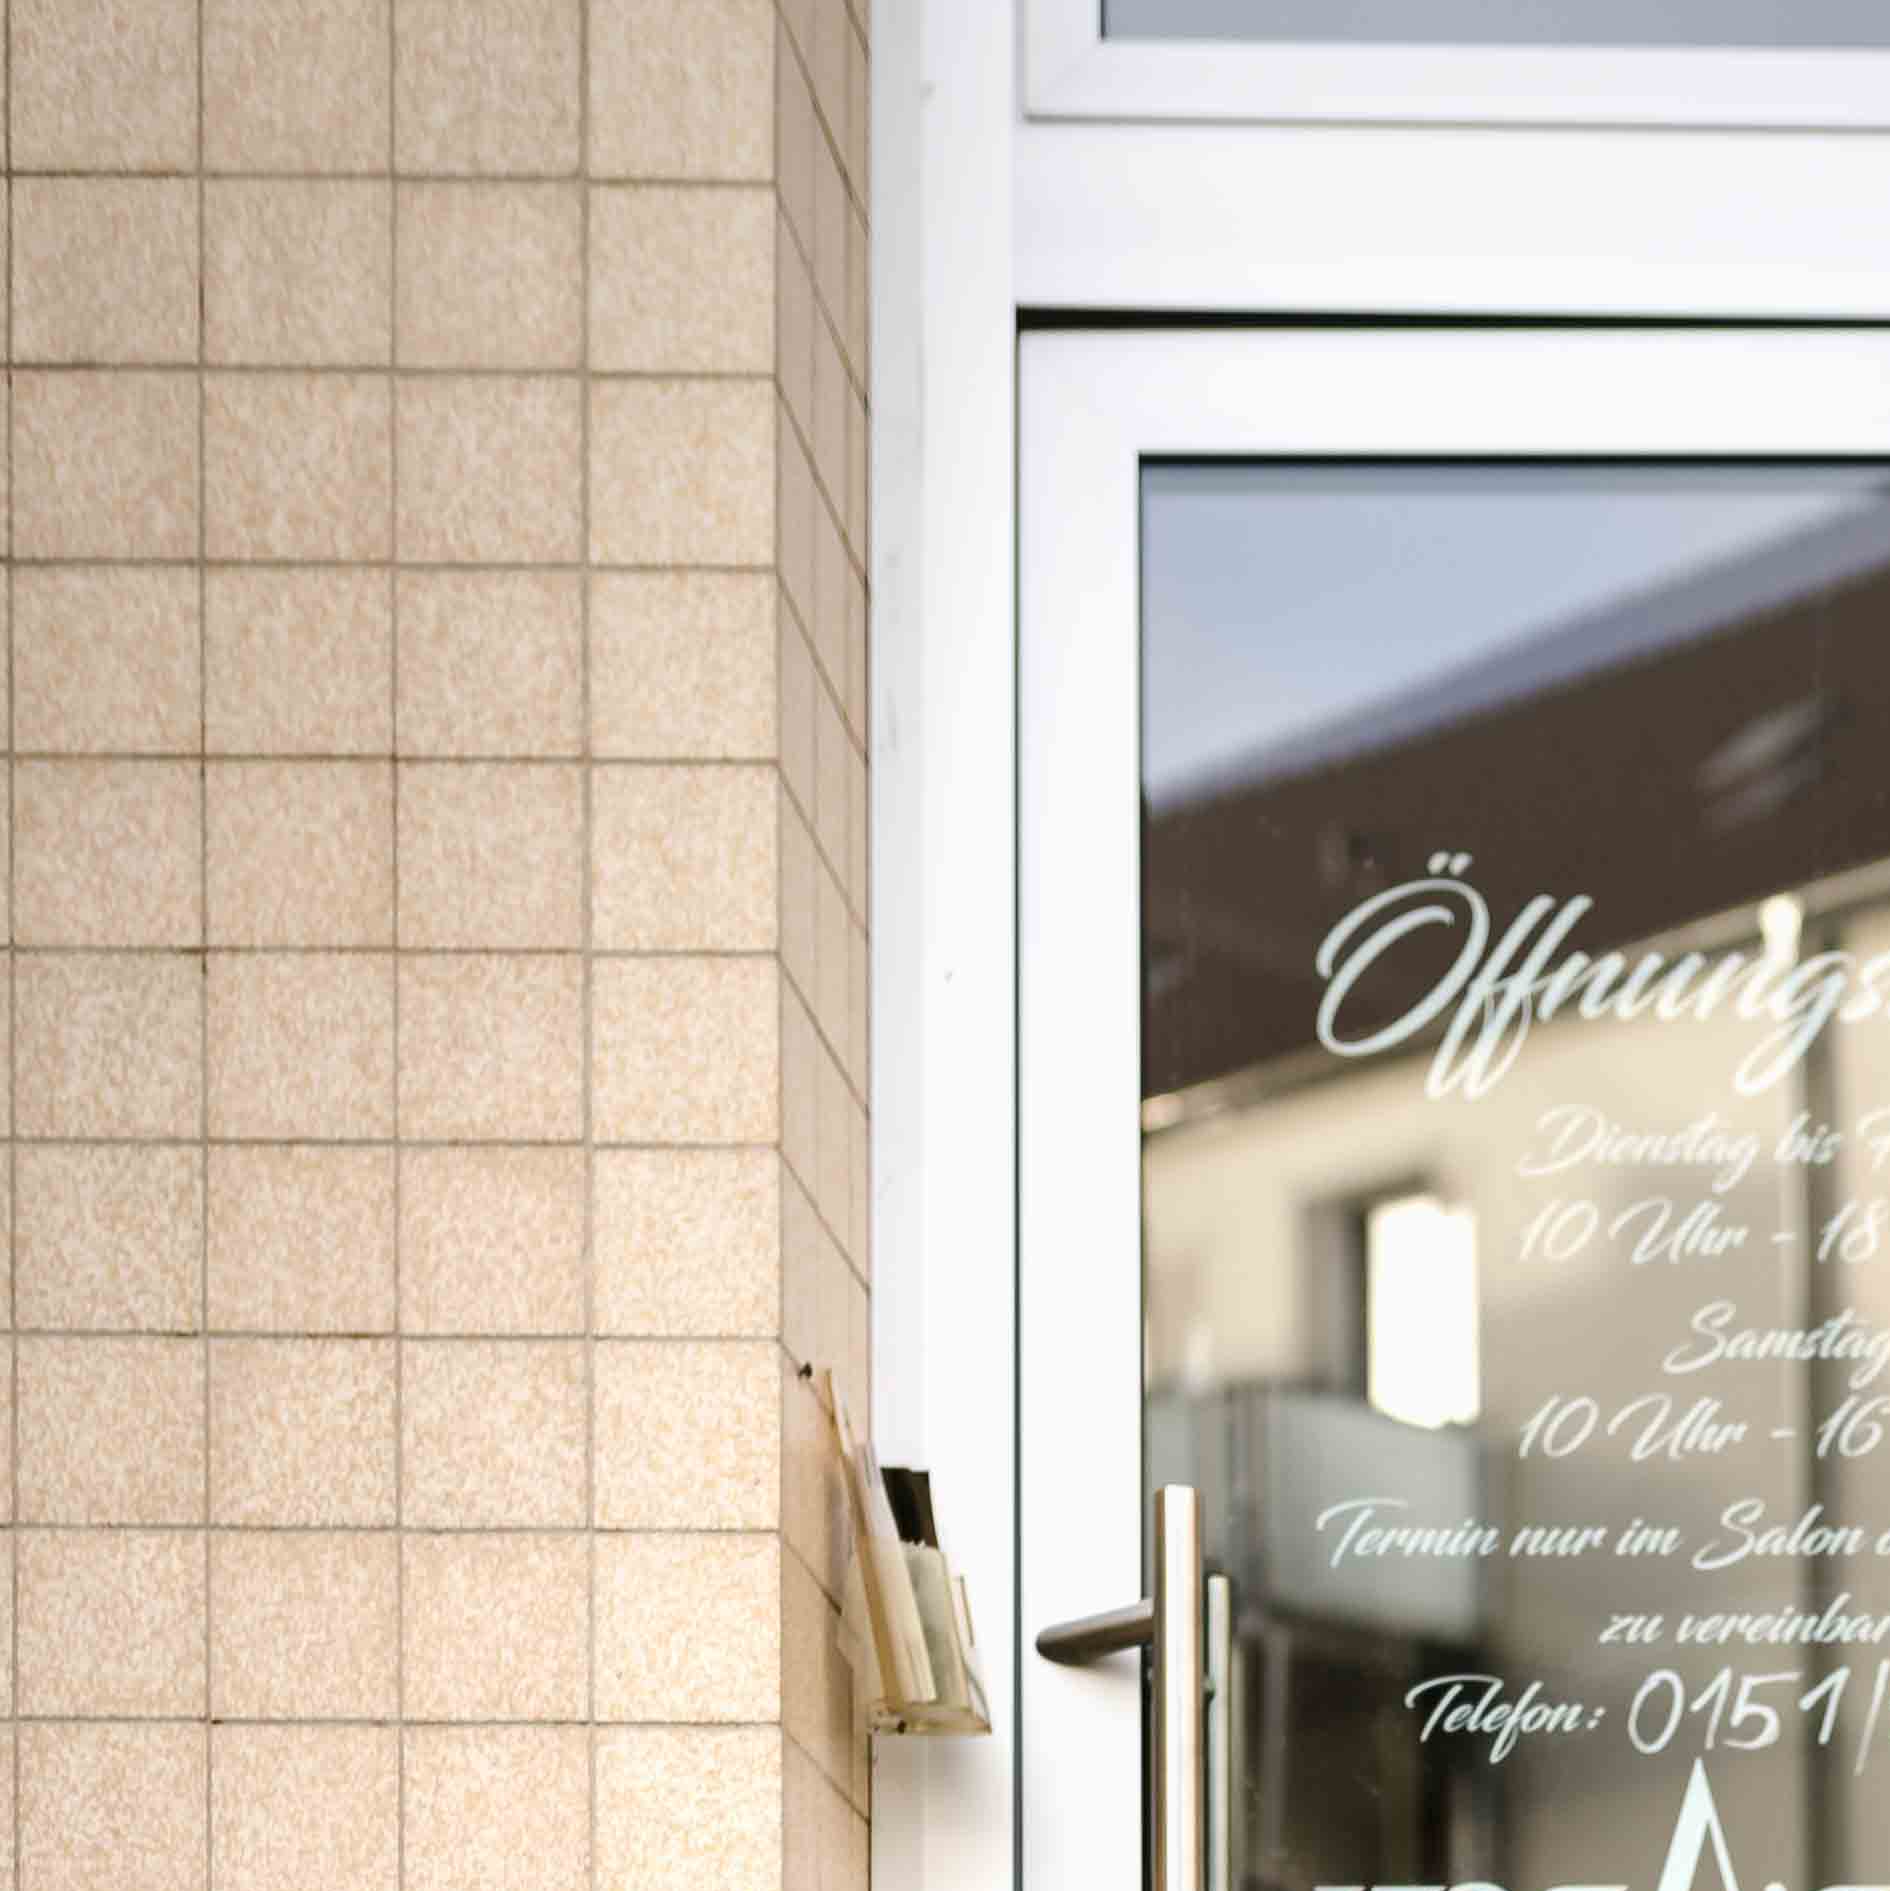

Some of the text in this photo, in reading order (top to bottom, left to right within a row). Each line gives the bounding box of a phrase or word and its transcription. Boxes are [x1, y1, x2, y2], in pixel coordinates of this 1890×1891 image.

[1514, 1102, 1760, 1194] Dienstag
[1773, 1108, 1841, 1165] bis
[1519, 1198, 1600, 1262] 10
[1607, 1195, 1748, 1265] Uhr
[1817, 1199, 1890, 1264] 18
[1518, 1395, 1600, 1459] 10
[1606, 1392, 1748, 1461] Uhr
[1315, 1497, 1500, 1568] Termin
[1509, 1525, 1605, 1556] nur
[1615, 1518, 1682, 1557] im
[1691, 1497, 1865, 1570] Salon
[1599, 1612, 1667, 1644] zu
[1404, 1673, 1606, 1764] Telefon:
